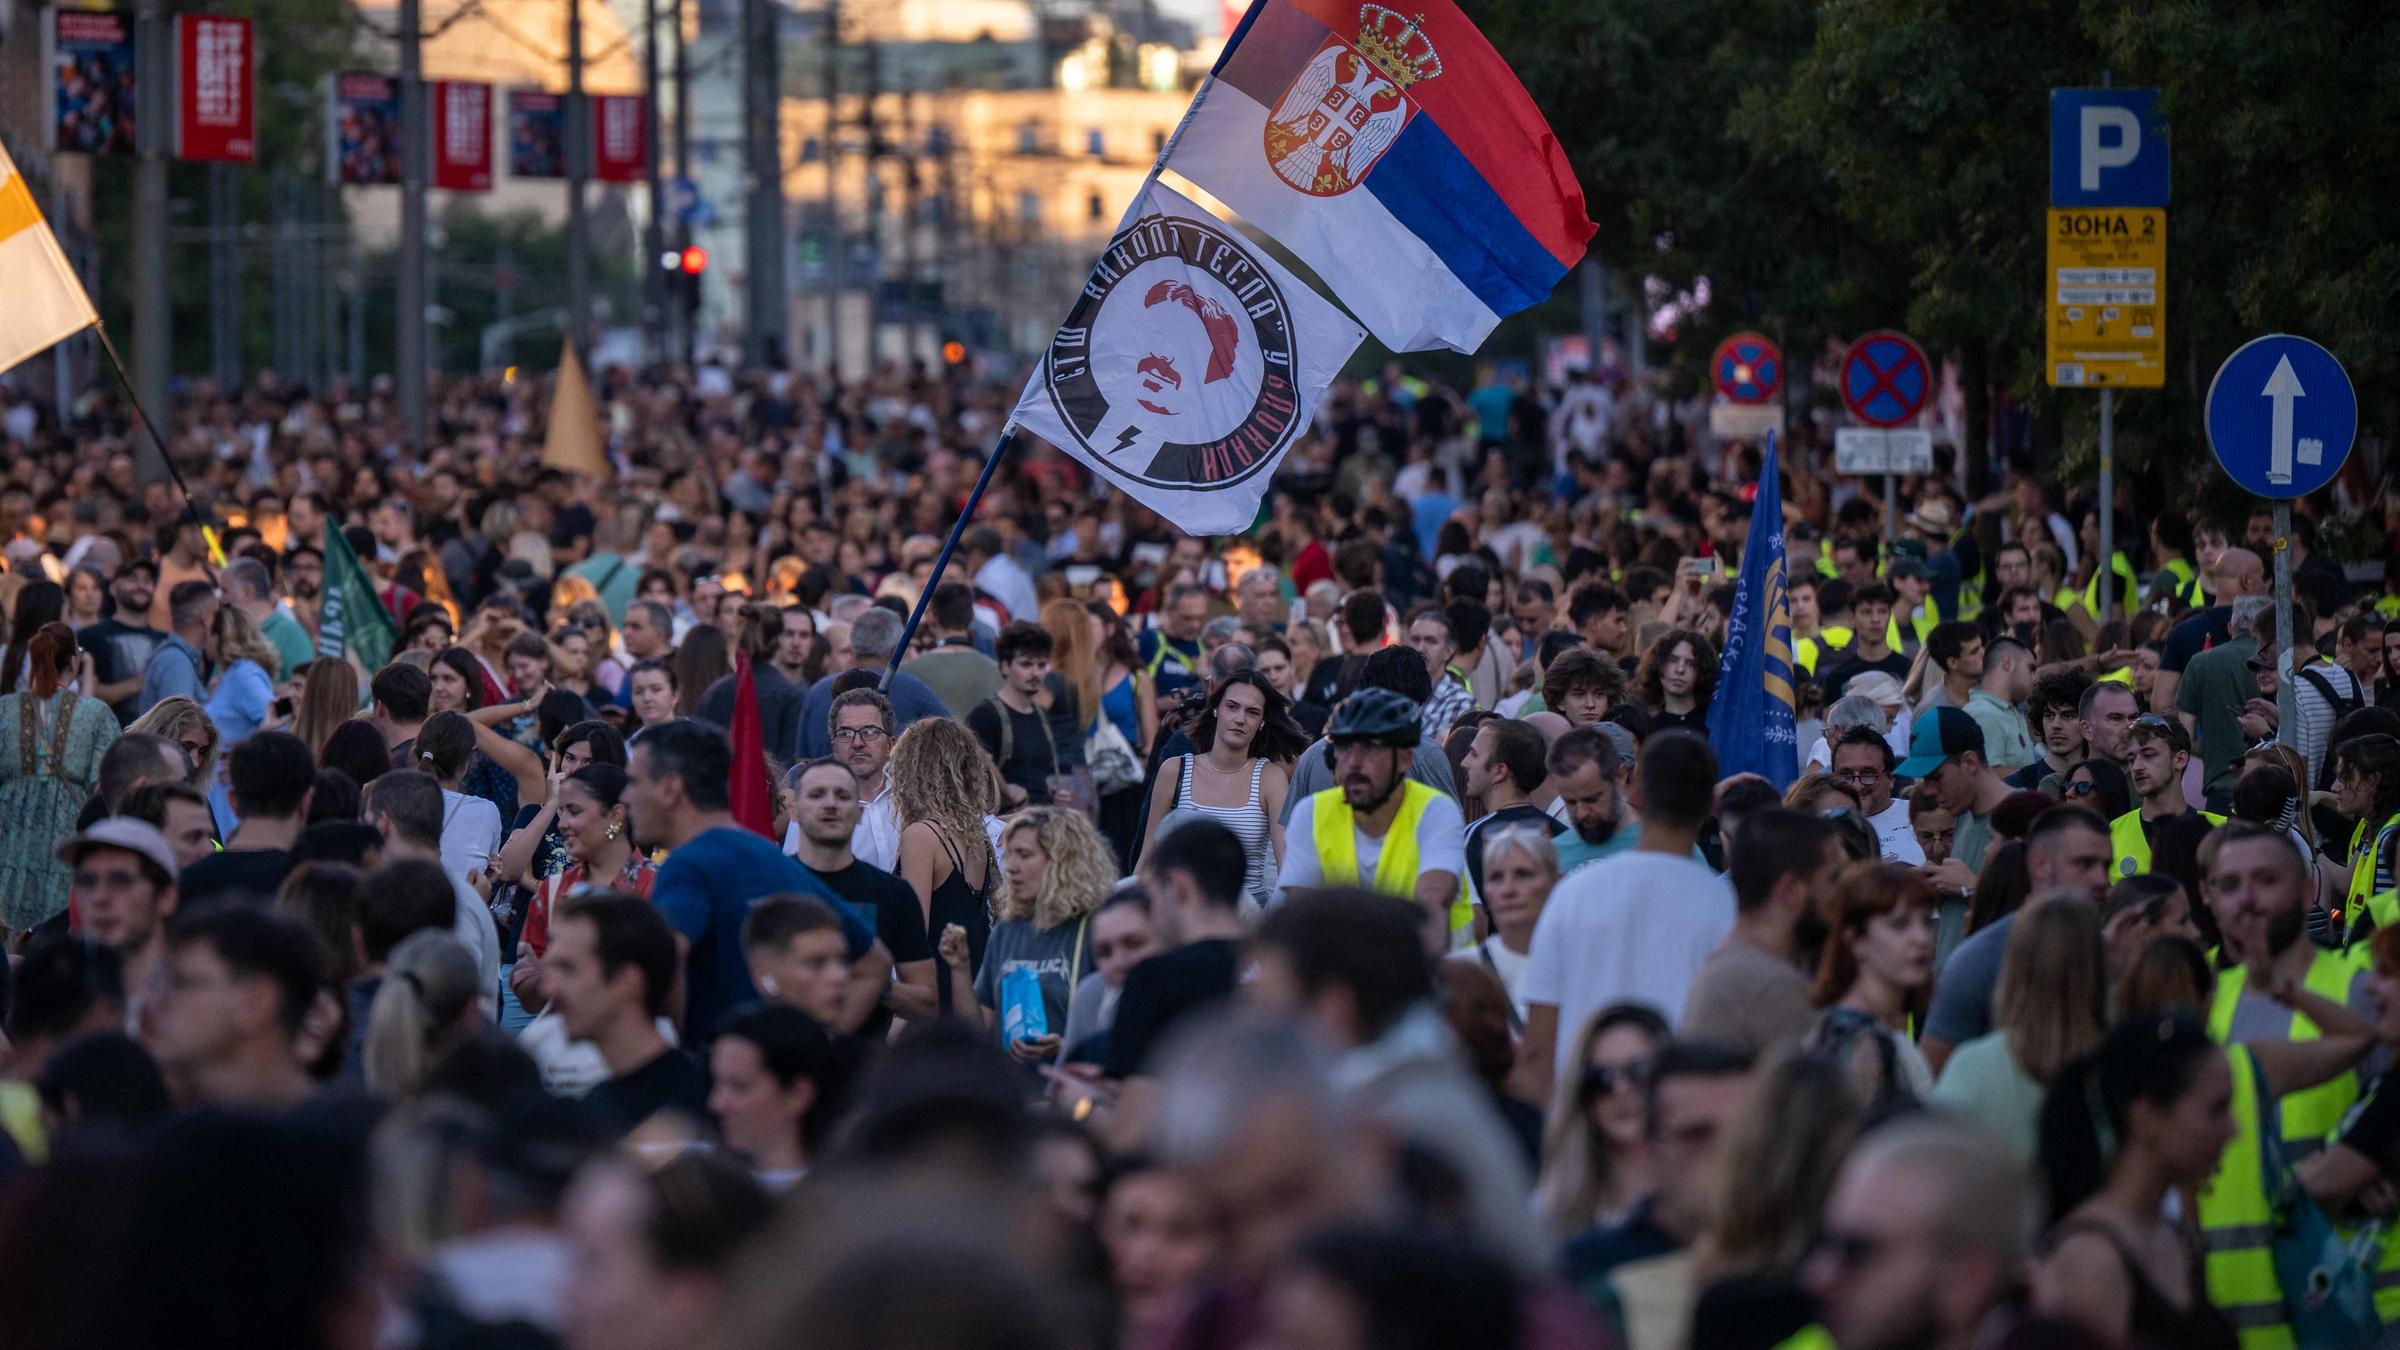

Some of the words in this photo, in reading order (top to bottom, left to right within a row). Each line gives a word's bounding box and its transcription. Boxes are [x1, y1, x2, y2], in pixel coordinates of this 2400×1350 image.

[2080, 106, 2141, 190] P
[2058, 215, 2129, 236] ЗОНА
[2142, 215, 2155, 236] 2
